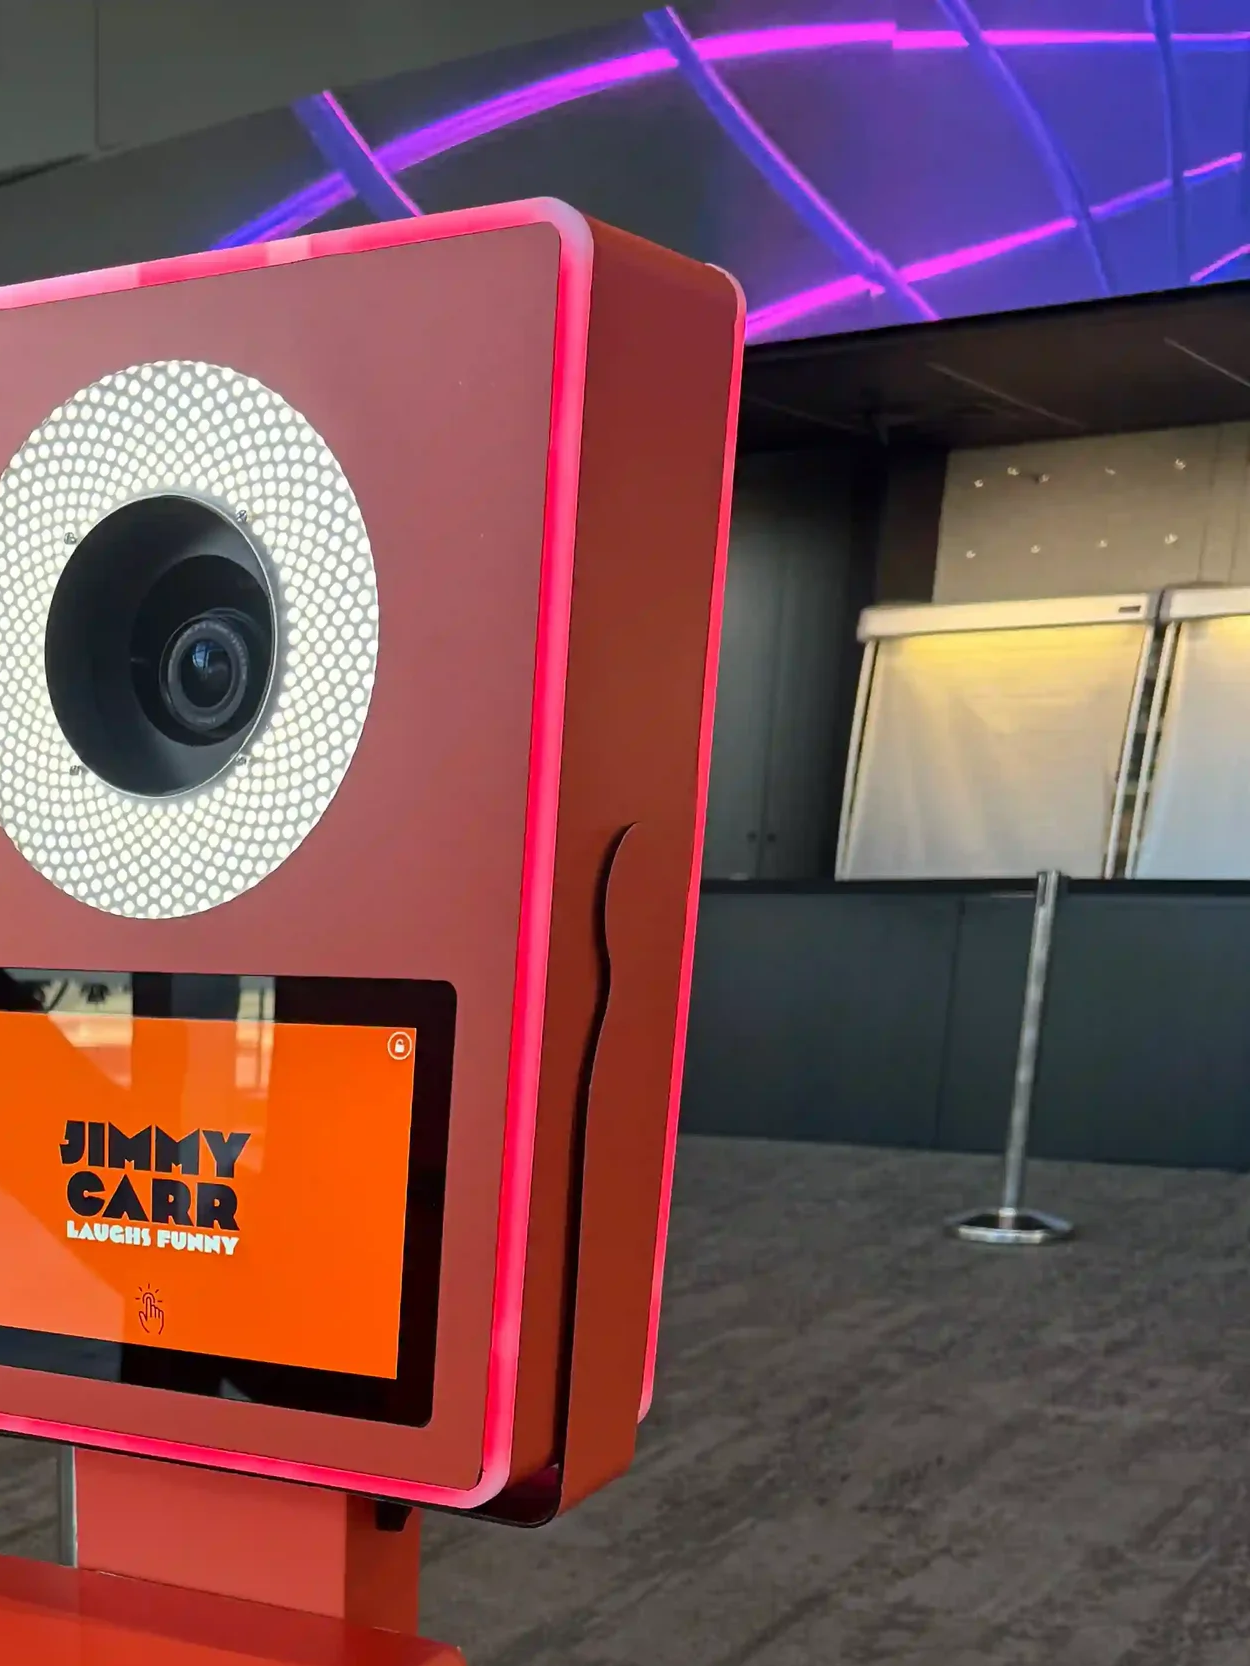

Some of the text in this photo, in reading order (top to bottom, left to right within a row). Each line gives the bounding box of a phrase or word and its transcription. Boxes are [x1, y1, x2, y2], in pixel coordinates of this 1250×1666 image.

[59, 1120, 251, 1179] JIMMY
[66, 1170, 239, 1231] CARR
[66, 1220, 240, 1256] LAUGHS FUNNY
